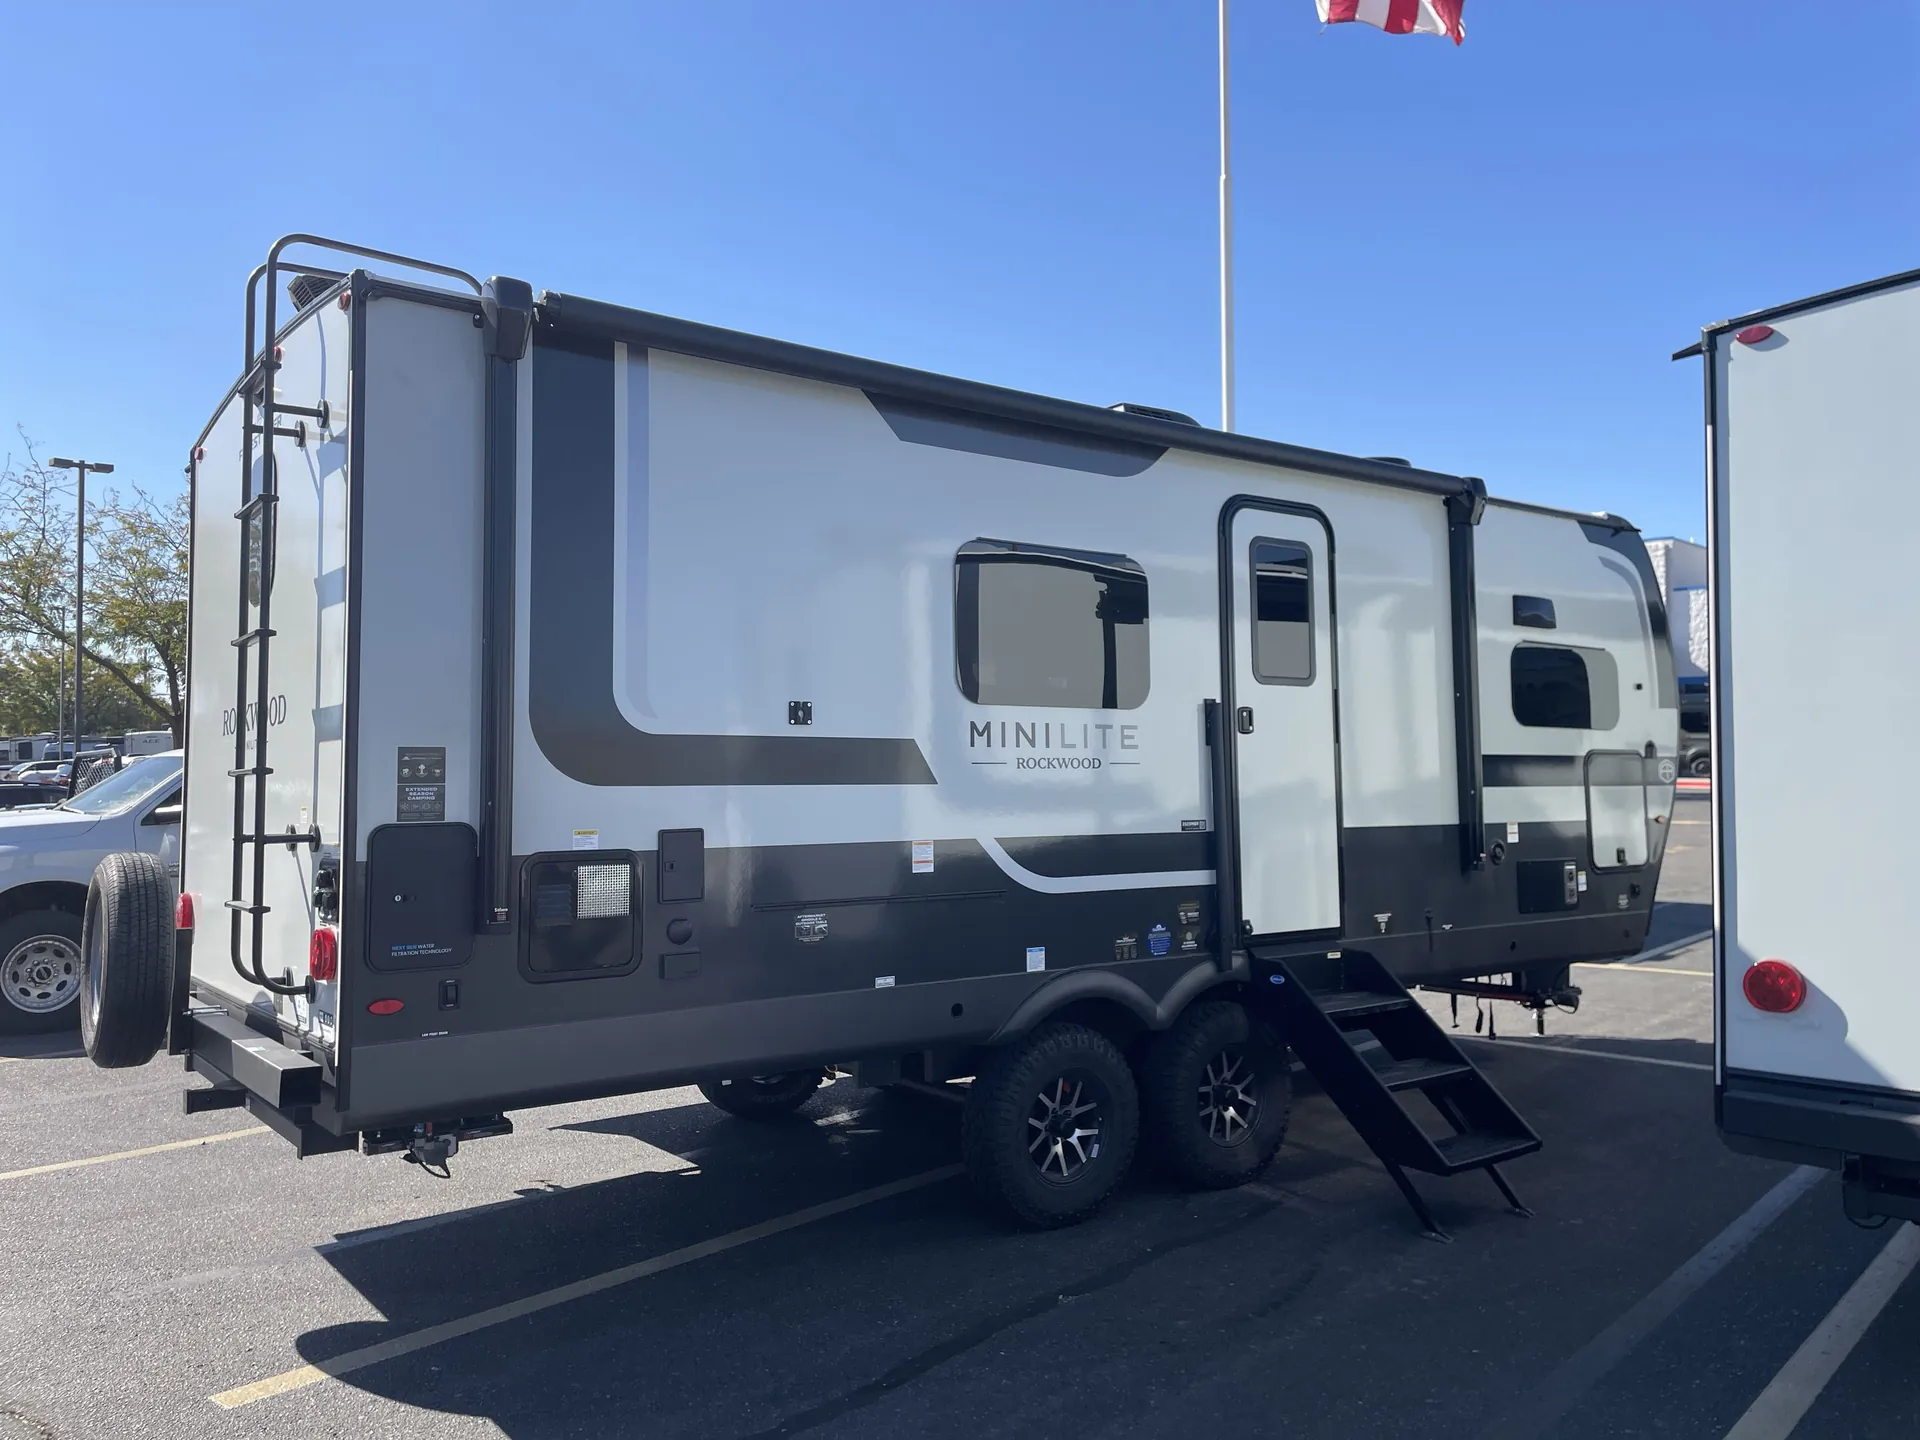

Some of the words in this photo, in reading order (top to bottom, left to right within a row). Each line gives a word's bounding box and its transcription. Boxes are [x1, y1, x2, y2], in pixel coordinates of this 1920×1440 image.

[222, 694, 287, 736] ROKWOD
[969, 720, 1139, 750] MINILITE
[1016, 757, 1102, 770] ROCKWOOD
[391, 949, 419, 957] FILTRATION
[419, 947, 452, 955] TECHNOLOGY
